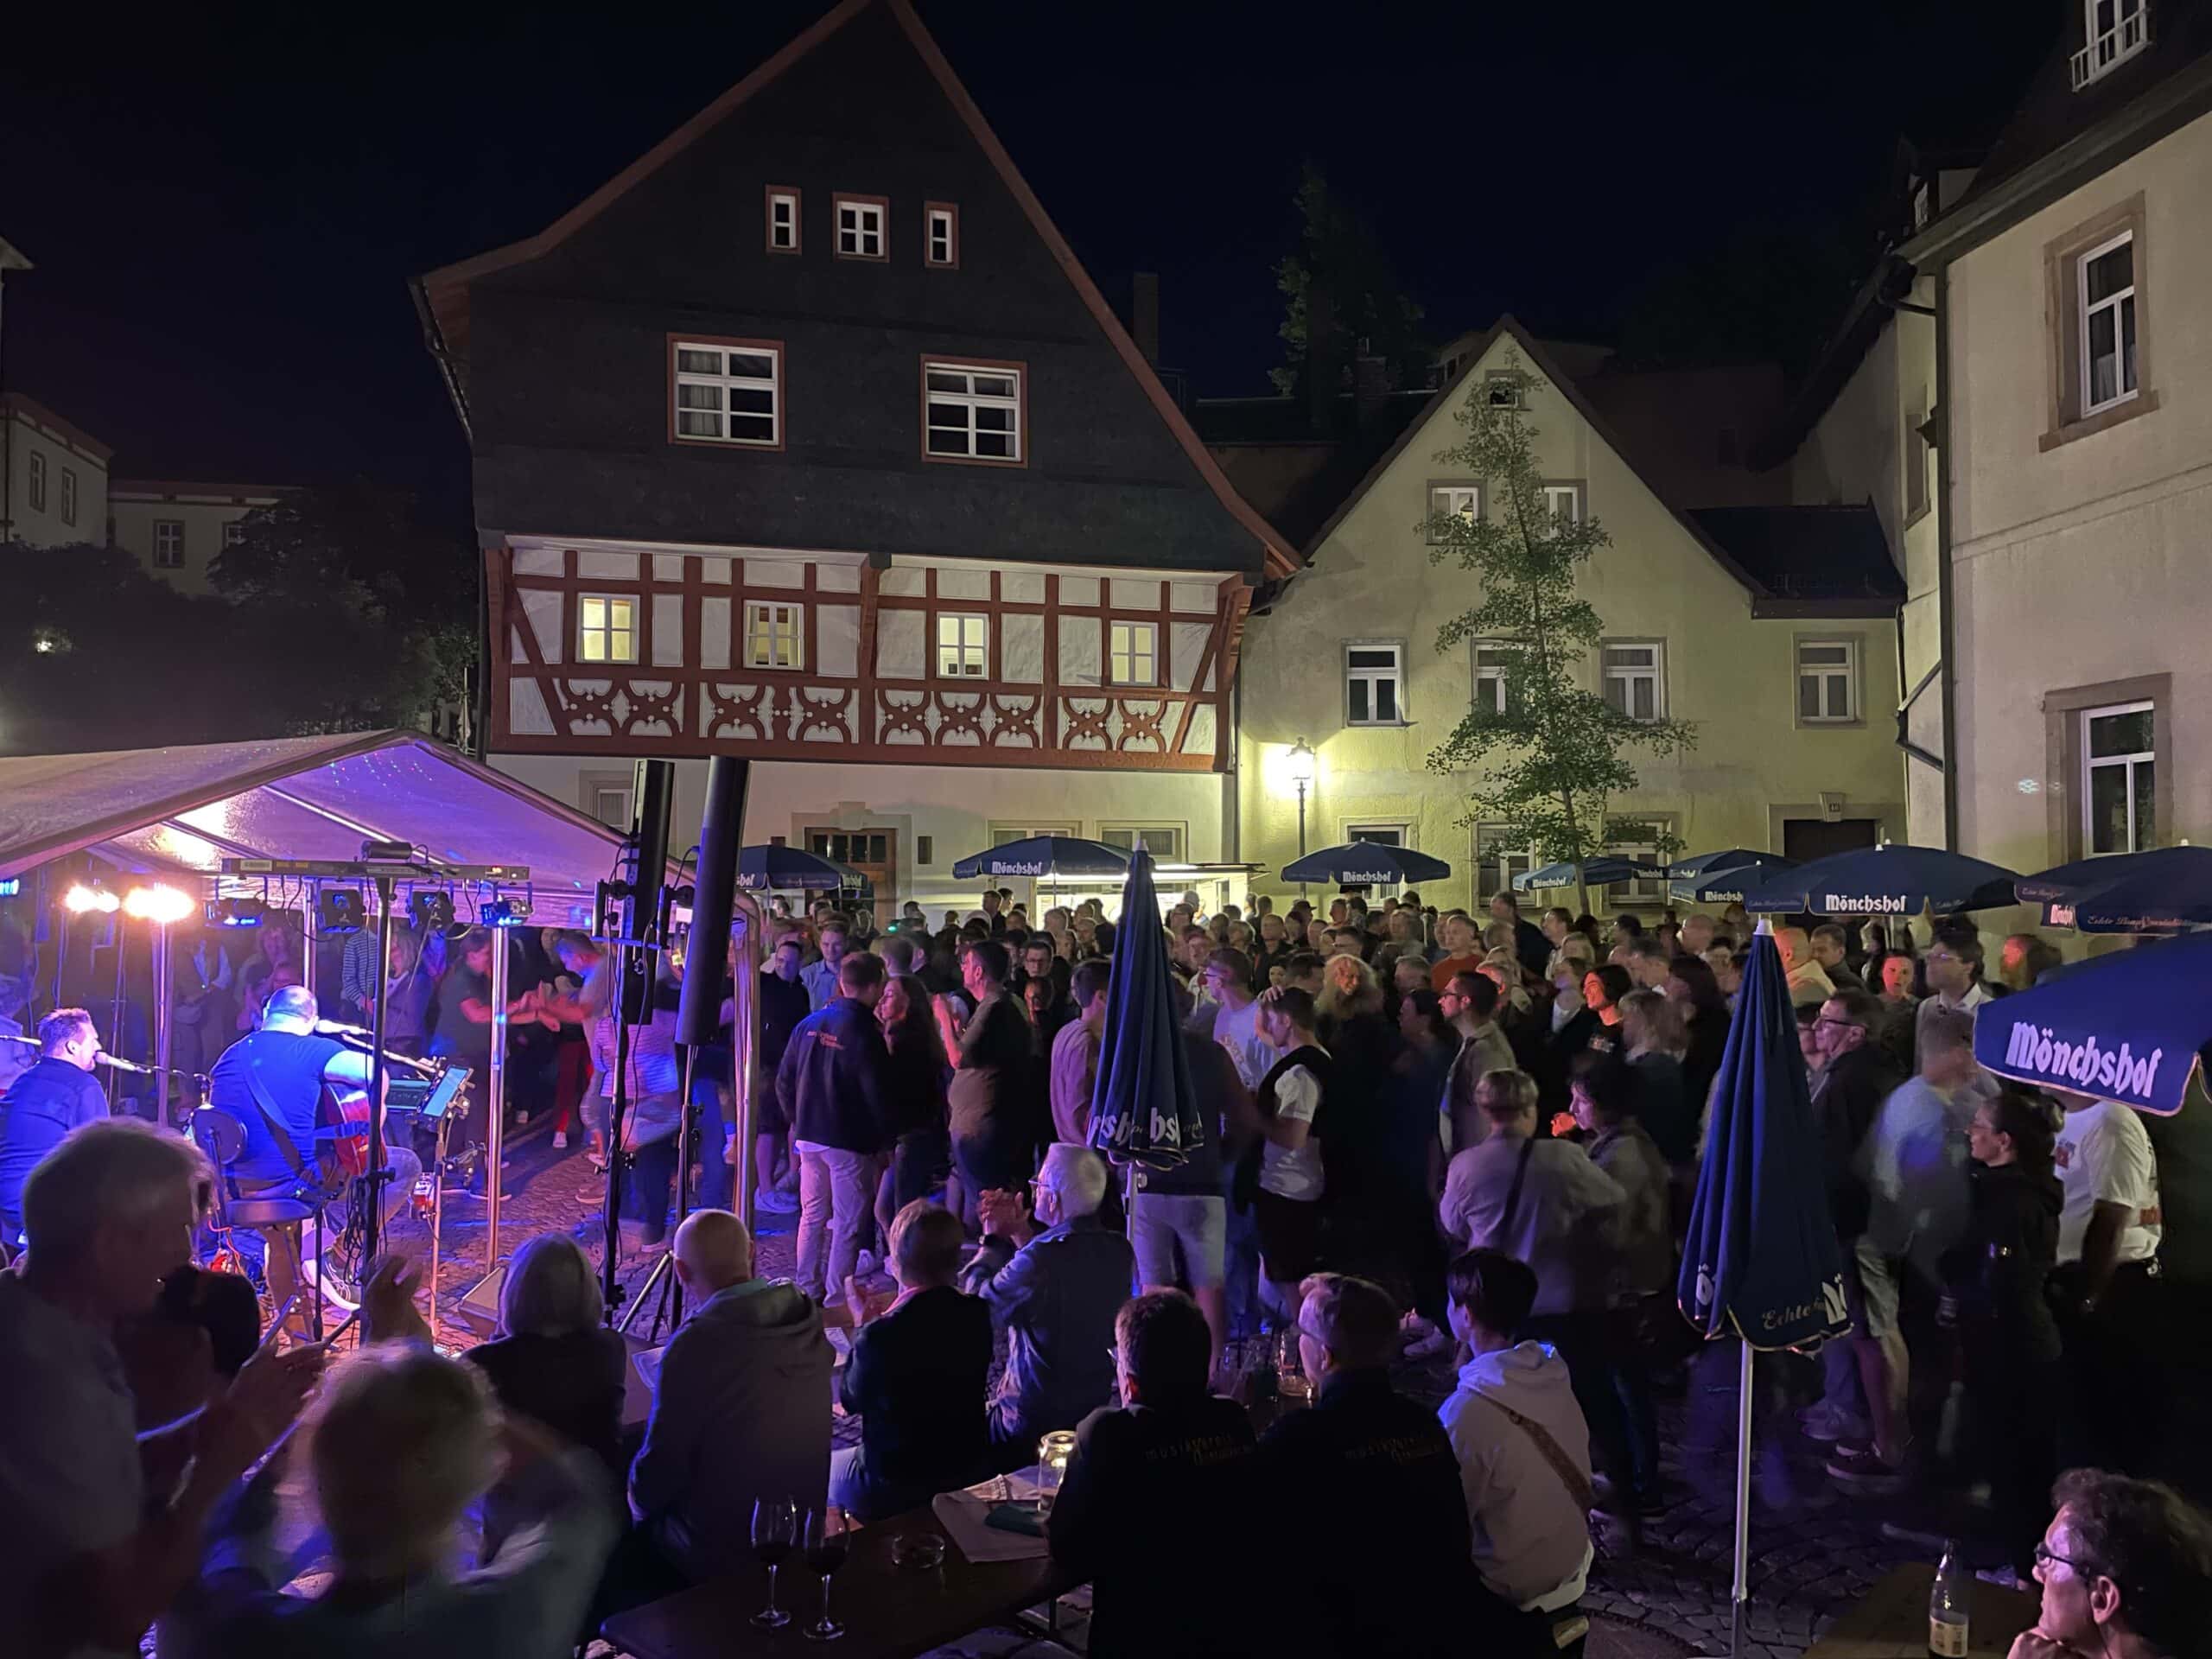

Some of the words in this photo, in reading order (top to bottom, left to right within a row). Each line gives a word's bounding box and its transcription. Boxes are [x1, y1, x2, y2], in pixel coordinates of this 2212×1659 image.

[991, 861, 1042, 874] Mönchshof
[1343, 870, 1391, 882] Mönchshof
[1705, 890, 1743, 902] Mönchsh
[1825, 893, 1907, 912] Mönchshof
[2005, 1020, 2163, 1098] Mönchshof
